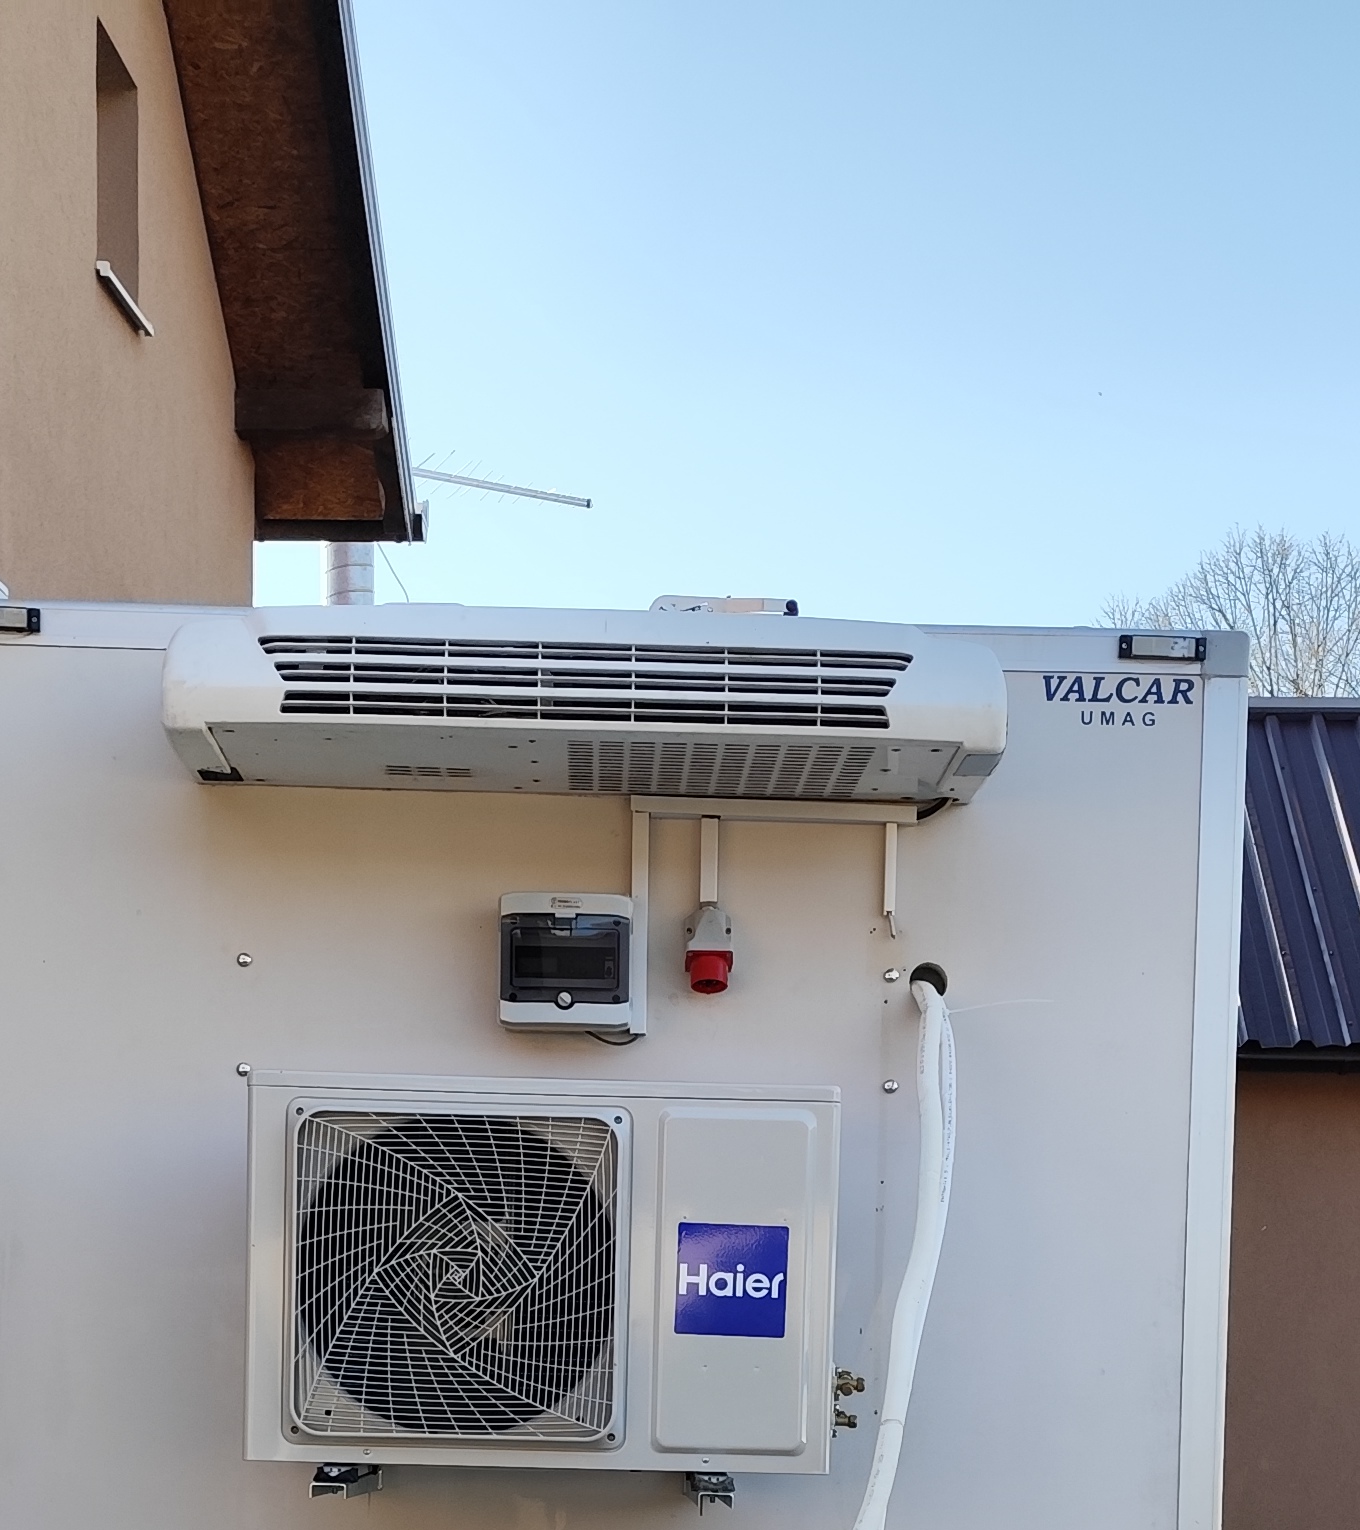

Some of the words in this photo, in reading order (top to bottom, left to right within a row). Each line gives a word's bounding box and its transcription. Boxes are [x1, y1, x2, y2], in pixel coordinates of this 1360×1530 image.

[1042, 675, 1196, 705] VALCAR
[1080, 710, 1157, 727] UMAG
[678, 1263, 785, 1299] Haier
